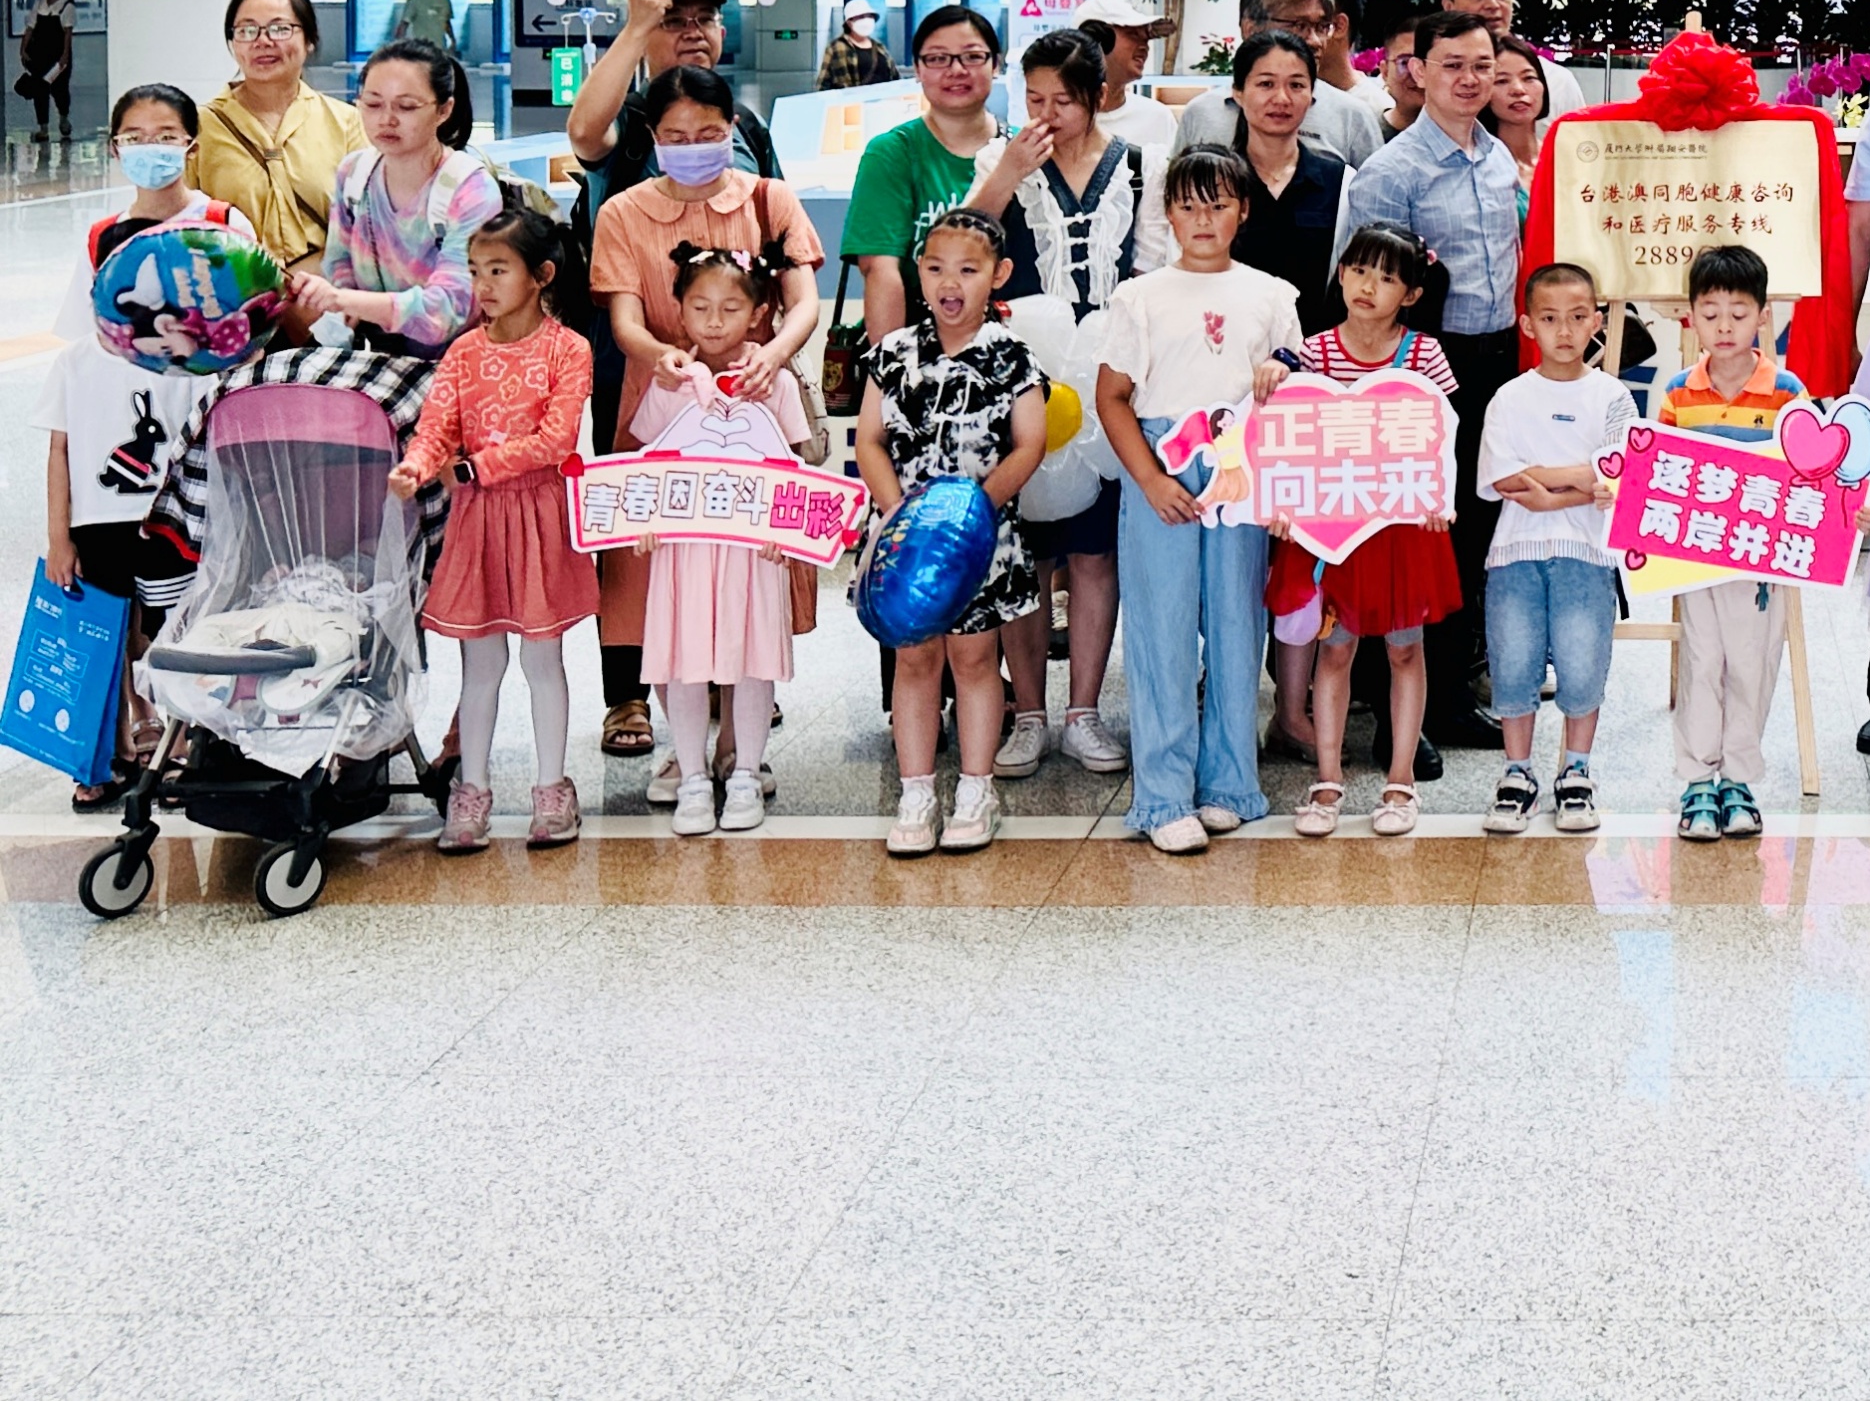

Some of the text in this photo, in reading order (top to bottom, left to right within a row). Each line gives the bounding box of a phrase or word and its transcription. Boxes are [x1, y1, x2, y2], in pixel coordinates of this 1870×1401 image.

[1580, 181, 1795, 204] 台港澳同胞健康咨询
[1601, 212, 1774, 237] 和医疗服务专线
[1634, 245, 1710, 267] 2889
[1257, 397, 1439, 458] 正青春
[583, 468, 846, 540] 青春因奋斗出彩
[1260, 456, 1440, 519] 向未来
[1647, 449, 1828, 531] 逐梦青春
[1637, 497, 1817, 579] 两岸并进
